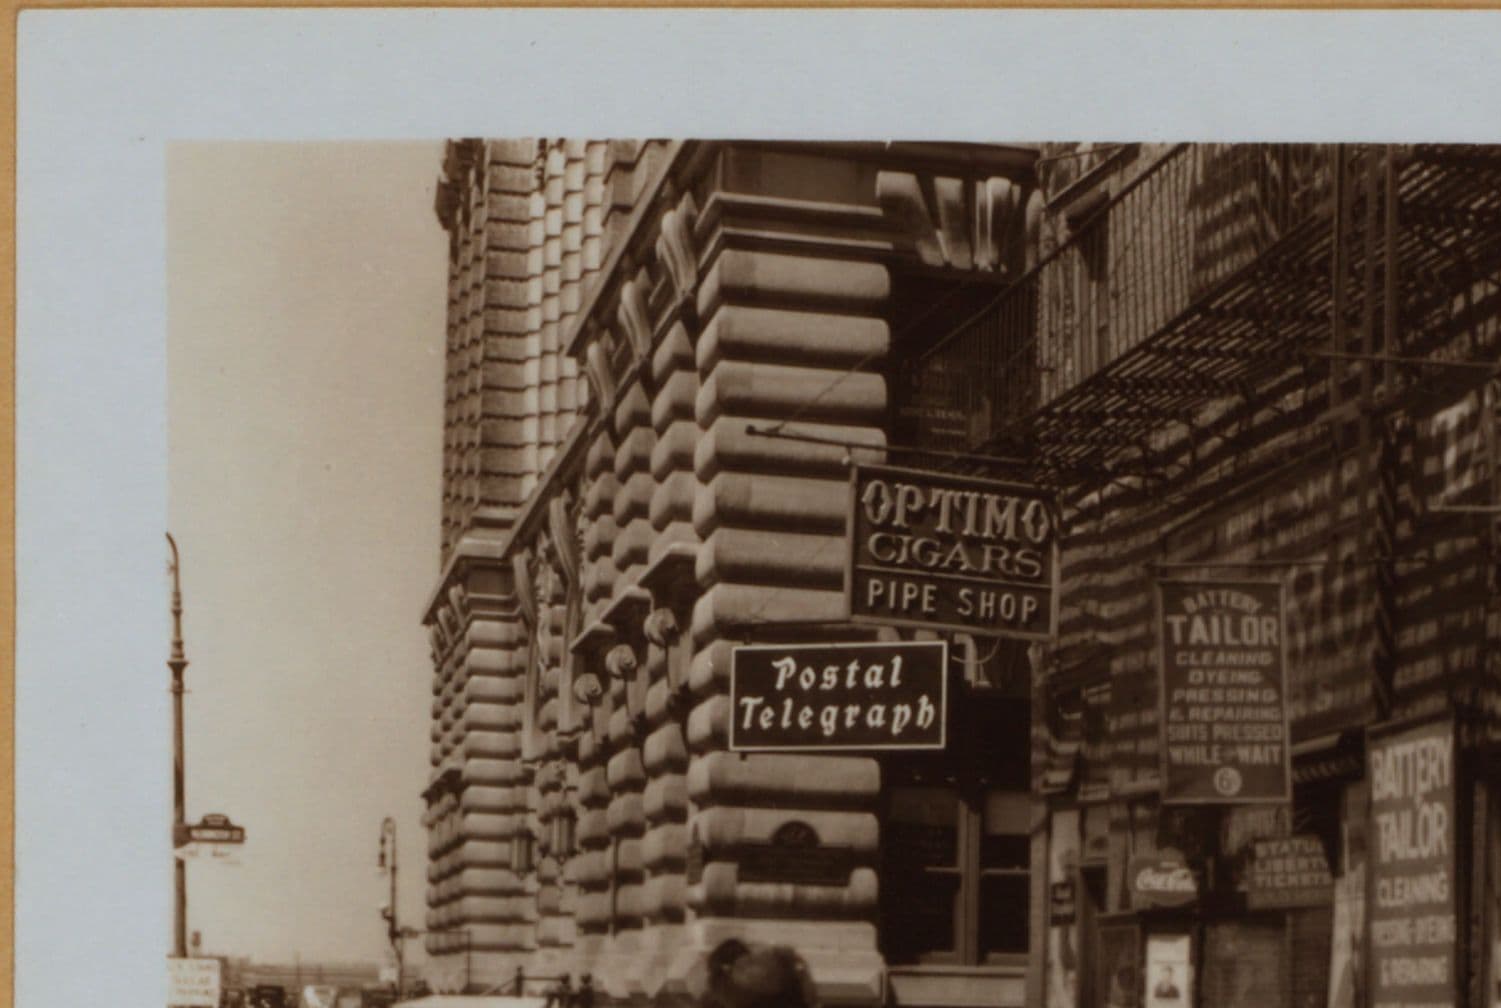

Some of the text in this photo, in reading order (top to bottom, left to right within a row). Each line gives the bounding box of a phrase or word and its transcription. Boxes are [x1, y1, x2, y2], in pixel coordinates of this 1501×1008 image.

[861, 479, 1050, 543] OPTIMO
[867, 531, 1042, 577] CIGARS
[867, 578, 1038, 623] PIPE SHOP
[1166, 614, 1280, 646] TAILOR
[771, 654, 904, 691] Postal
[1175, 650, 1275, 667] CLEANING
[1188, 668, 1264, 685] DYEING
[1173, 687, 1280, 704] PRESSING
[1188, 706, 1282, 722] REPAIRING
[739, 694, 936, 737] Telegraph
[1212, 723, 1282, 742] PRESSED
[1168, 744, 1222, 765] WHILE
[1236, 744, 1281, 764] WAIT
[1371, 735, 1455, 801] BATTERY
[1377, 802, 1448, 863] TAILOR
[1377, 871, 1449, 908] CLEANING
